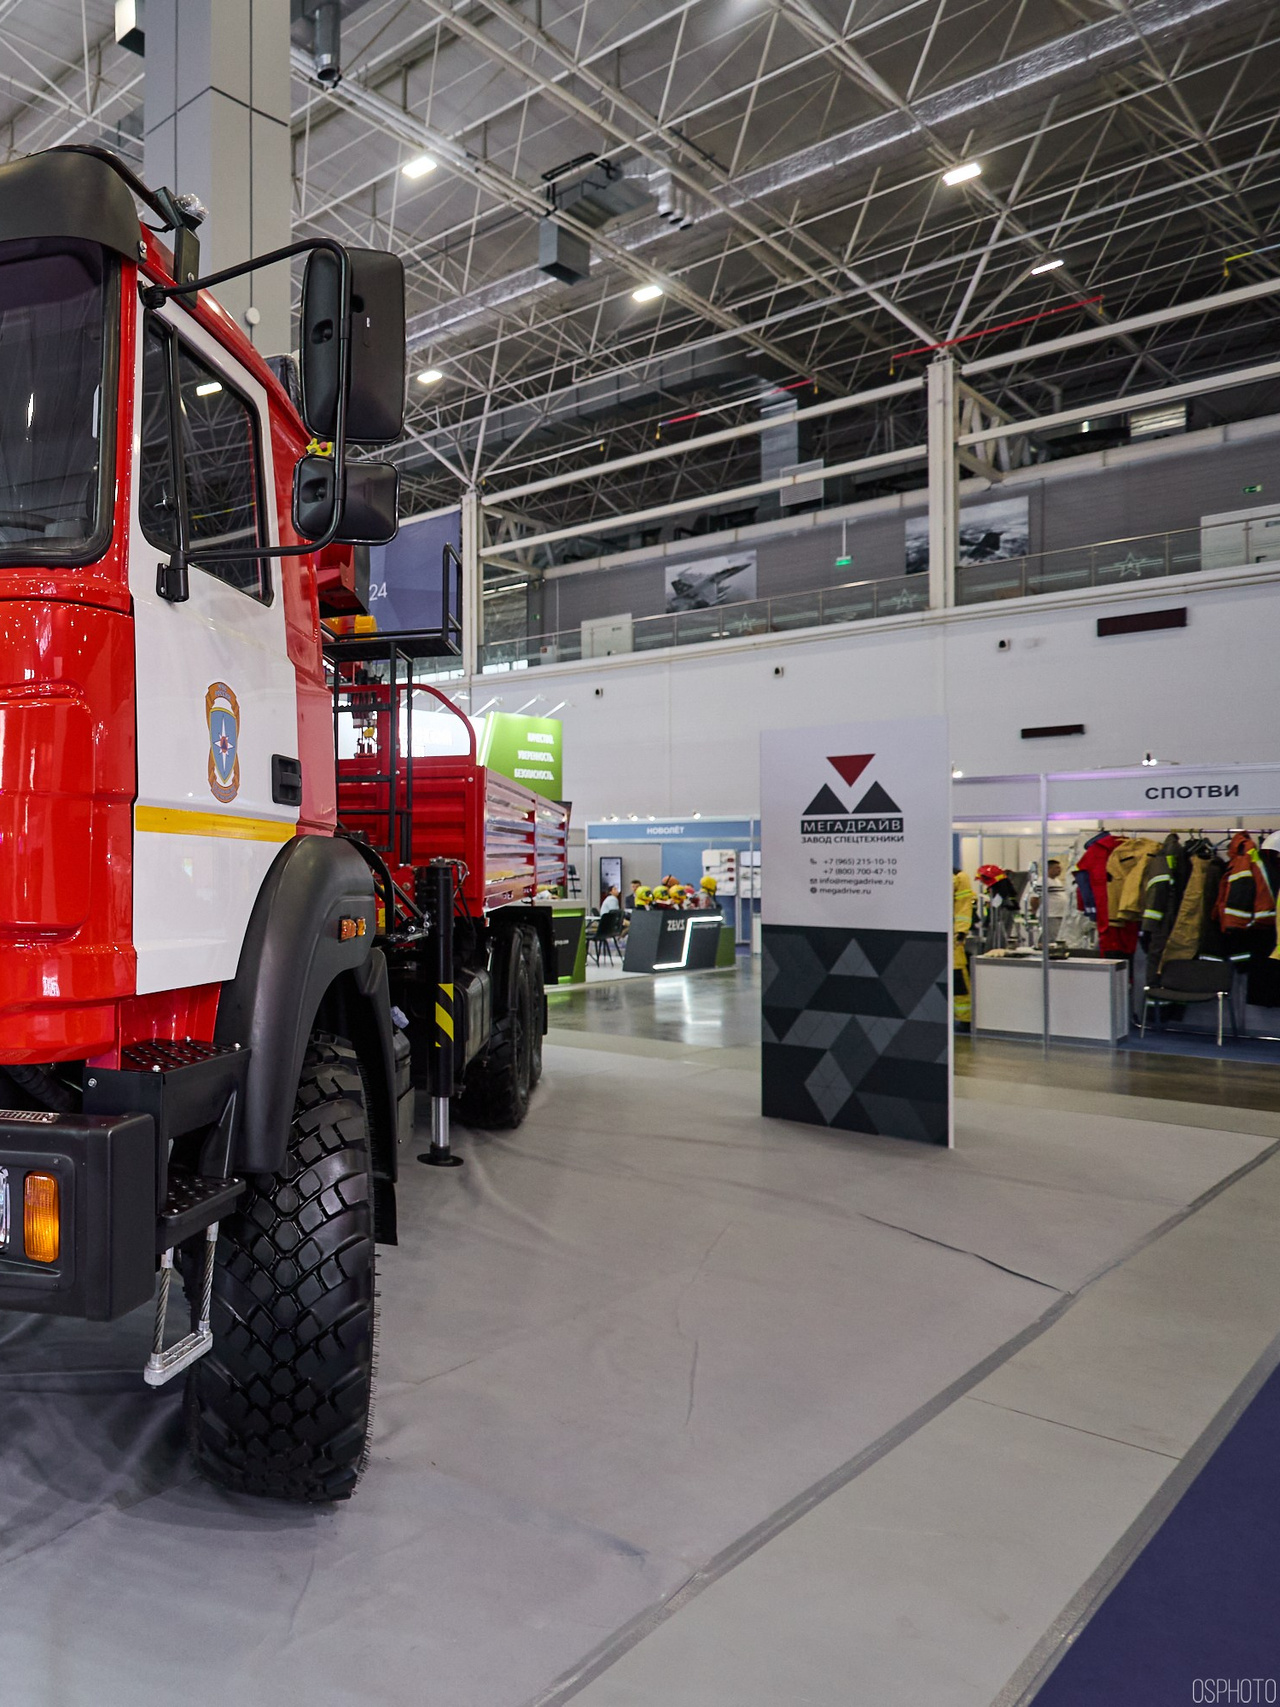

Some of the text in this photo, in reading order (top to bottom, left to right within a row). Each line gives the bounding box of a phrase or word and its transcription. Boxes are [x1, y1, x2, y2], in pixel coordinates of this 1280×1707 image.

[1145, 784, 1239, 800] СПОТВИ
[803, 819, 901, 833] МЕГАДРАЙВ
[801, 835, 904, 844] ЗАВОД СПЕЦТЕХНИКИ
[835, 868, 855, 876] (800)
[819, 877, 894, 886] info@megadrive.ru
[819, 887, 871, 895] megadrive.ru
